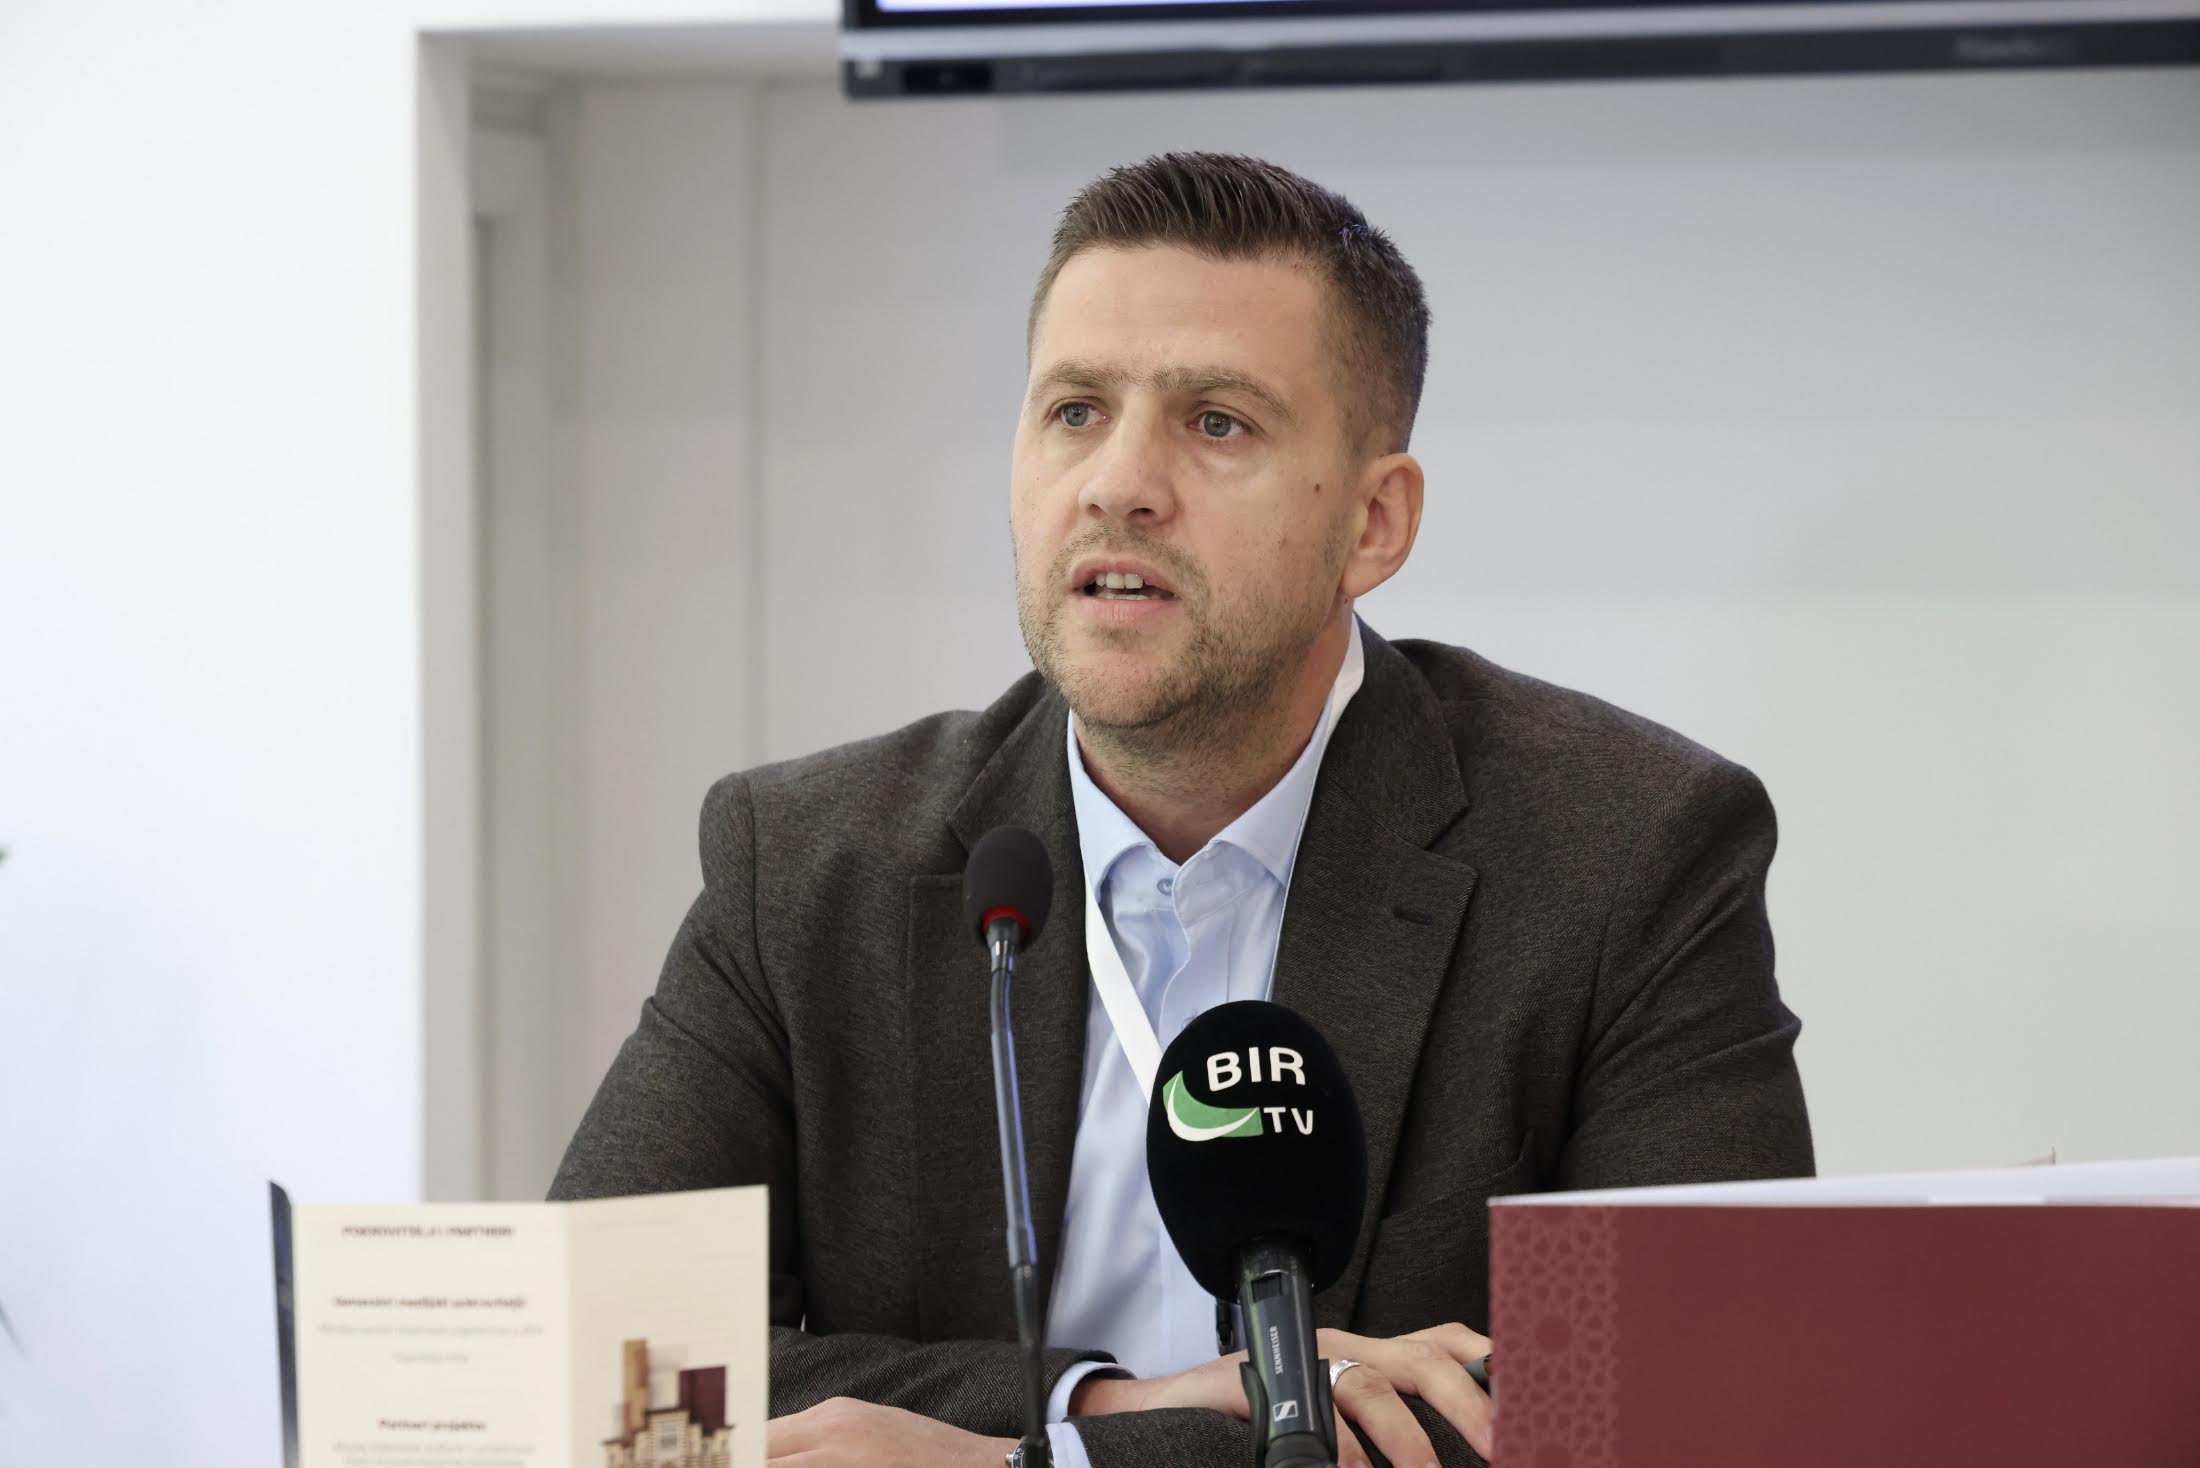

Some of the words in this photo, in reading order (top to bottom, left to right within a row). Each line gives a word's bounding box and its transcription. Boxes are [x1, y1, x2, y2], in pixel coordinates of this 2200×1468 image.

[1206, 1046, 1306, 1092] BIR
[1263, 1106, 1314, 1136] TV
[1269, 1325, 1284, 1375] SENNHEISER
